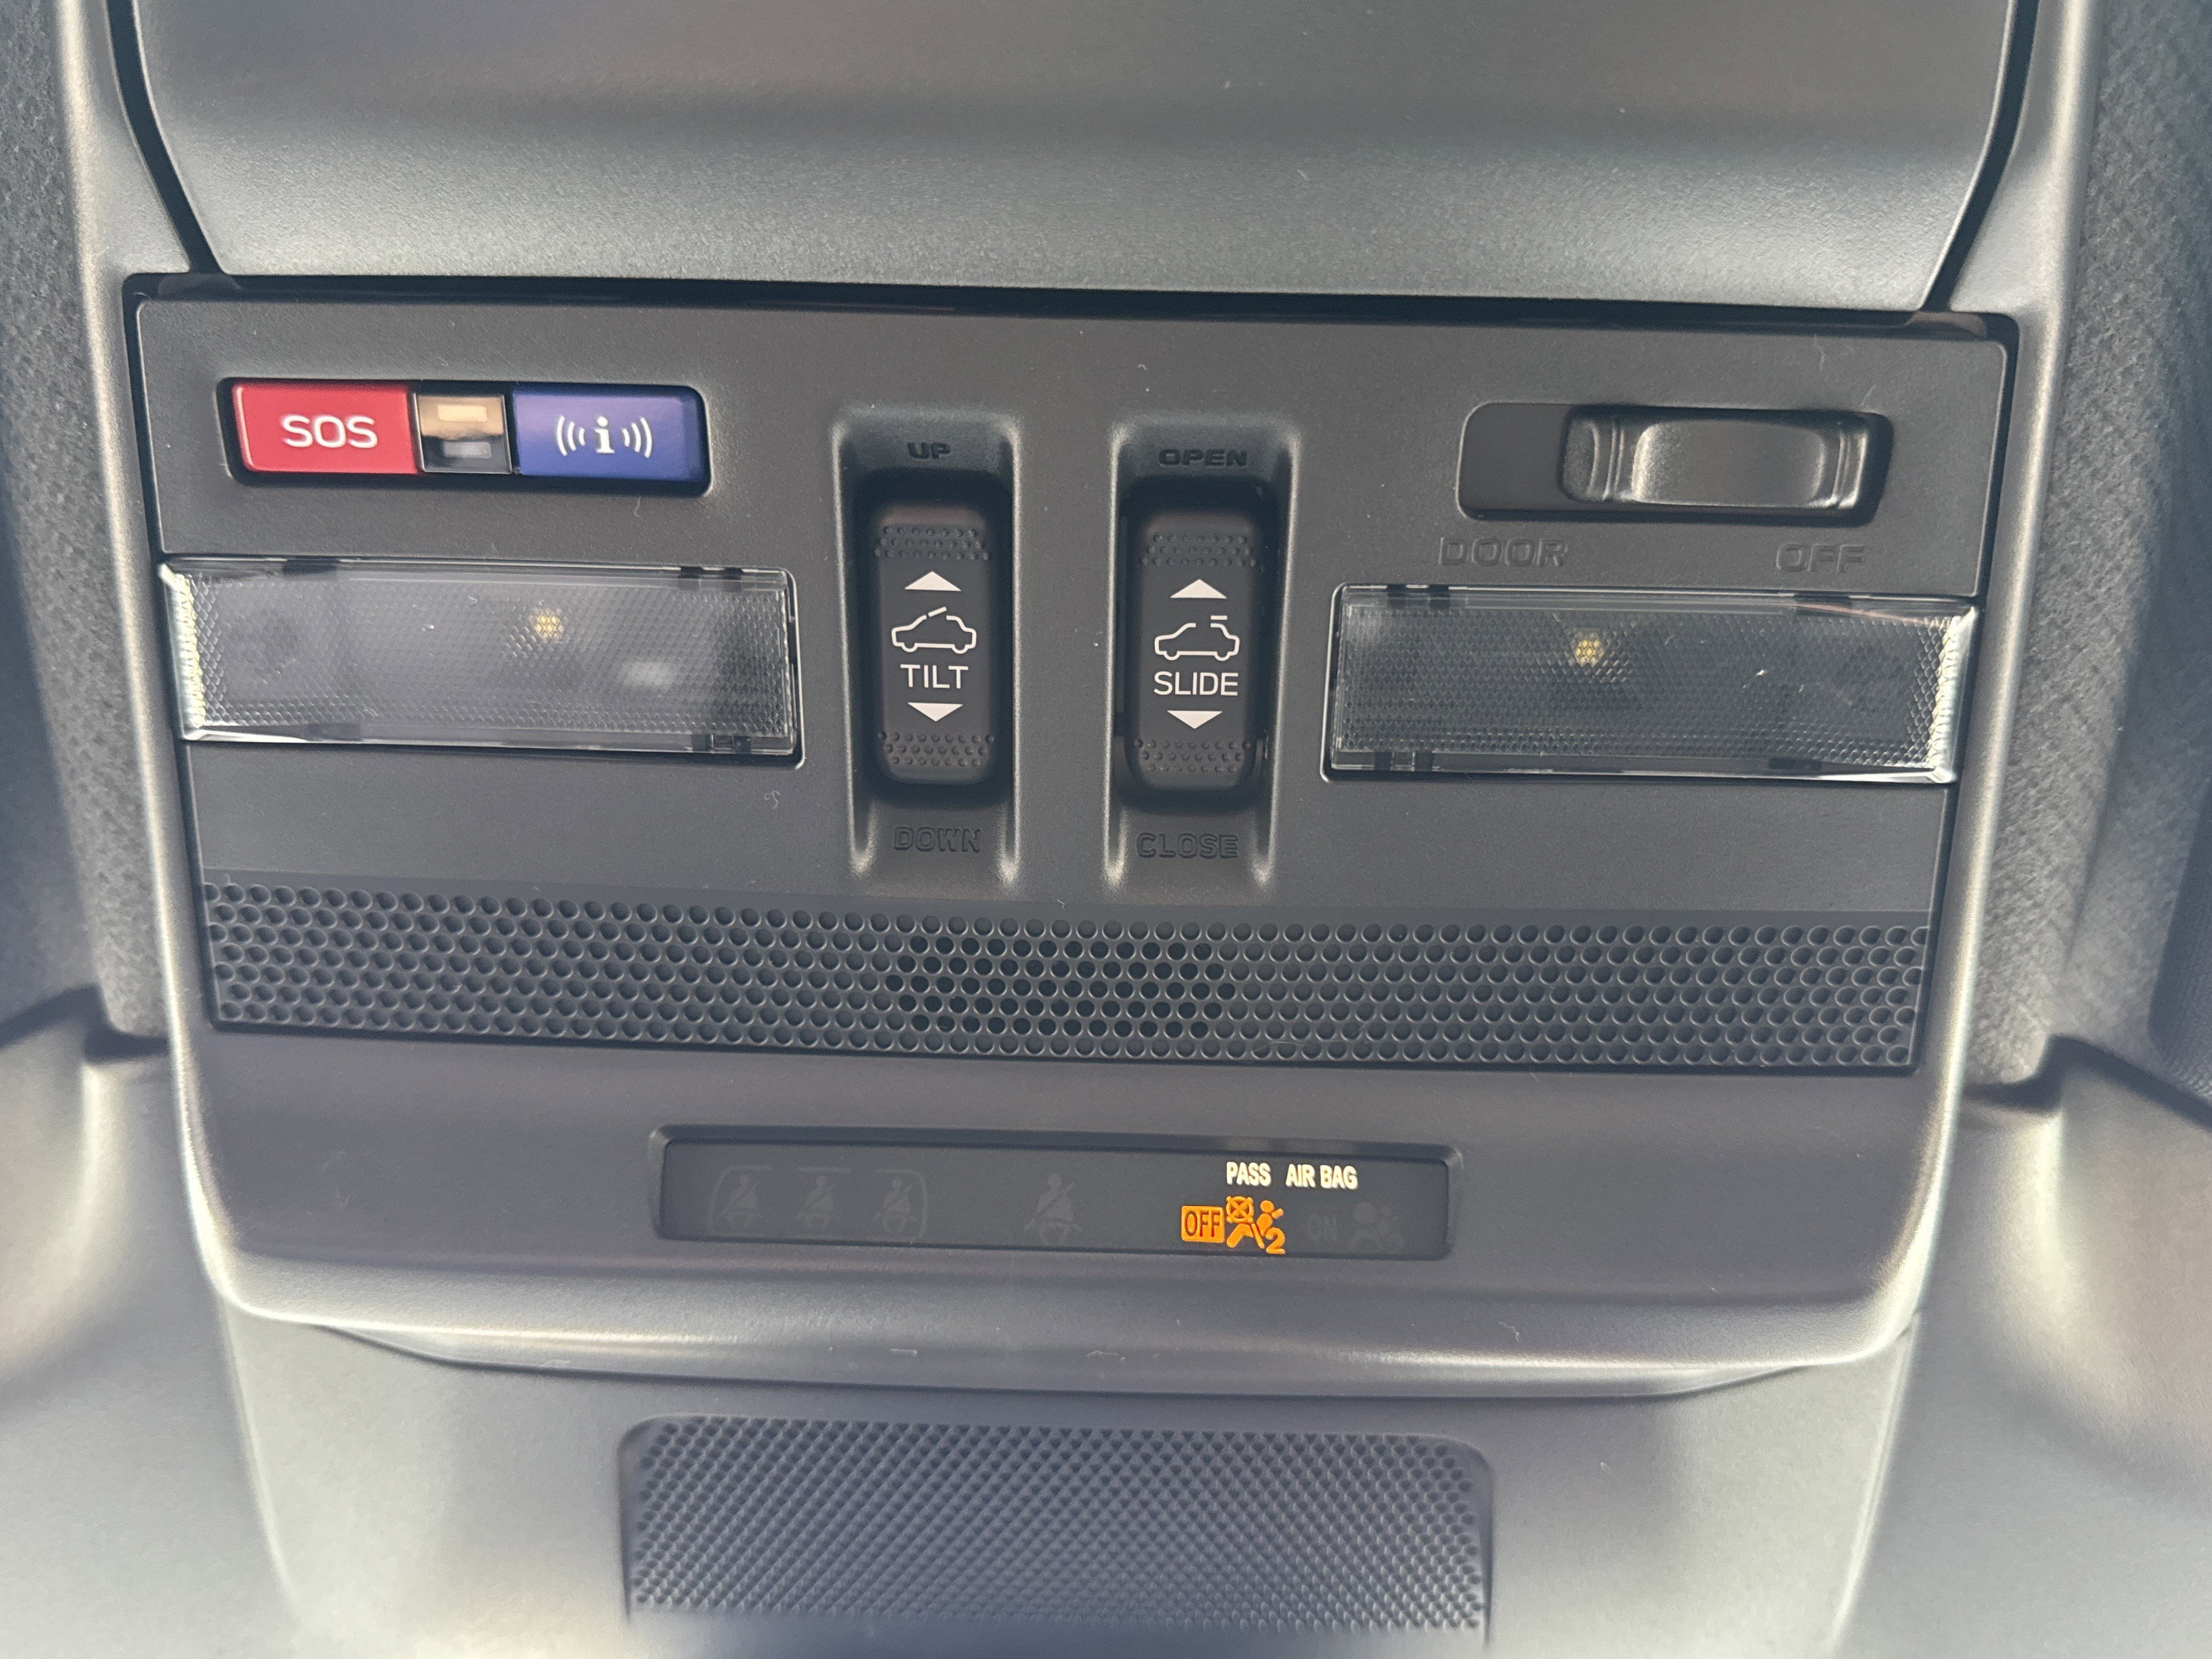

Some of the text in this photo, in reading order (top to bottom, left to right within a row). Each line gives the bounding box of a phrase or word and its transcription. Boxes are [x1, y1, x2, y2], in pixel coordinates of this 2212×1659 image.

[279, 414, 378, 449] SOS
[907, 442, 951, 460] UP
[1159, 448, 1248, 467] OPEN
[1438, 537, 1568, 567] DOOR
[1775, 543, 1866, 573] OFF
[900, 664, 969, 690] TILT
[1153, 671, 1239, 697] SLIDE
[893, 826, 982, 854] DOWN
[1136, 833, 1239, 860] CLOSE
[1226, 1161, 1358, 1190] PASS AIR BAG
[1184, 1210, 1222, 1238] OFF
[1265, 1227, 1286, 1255] 2
